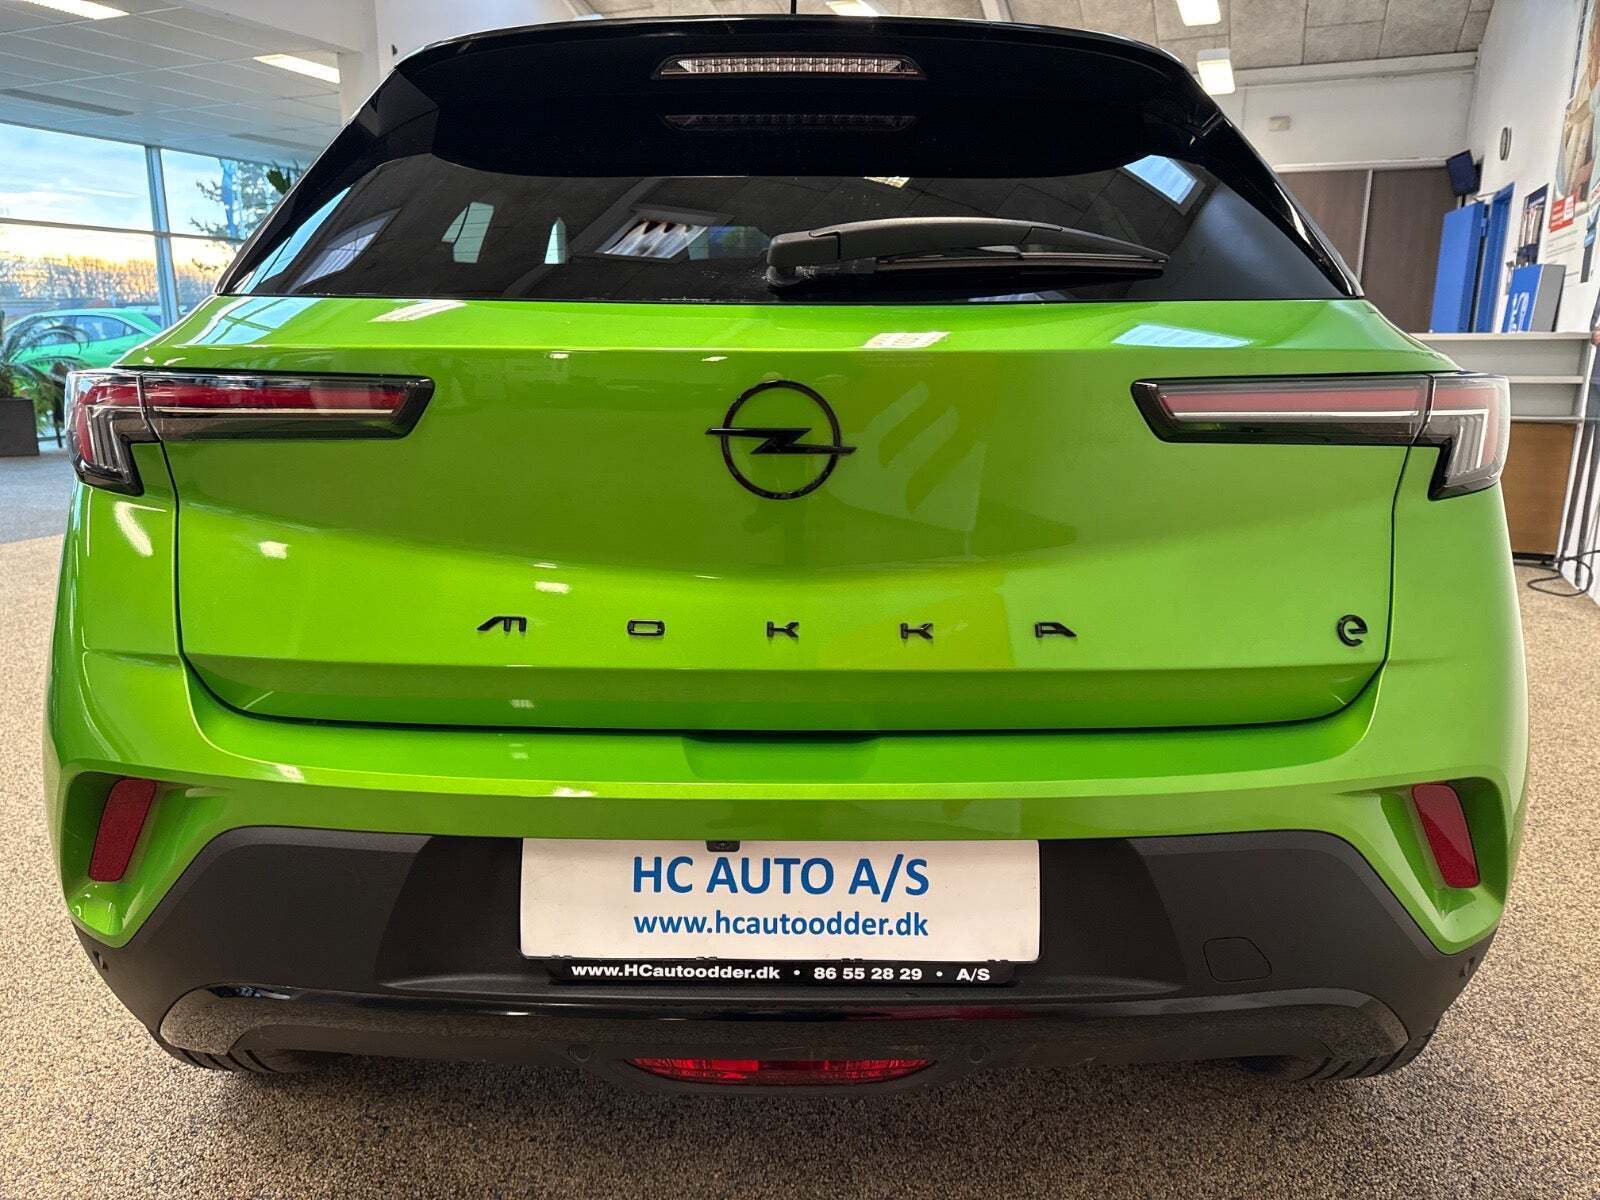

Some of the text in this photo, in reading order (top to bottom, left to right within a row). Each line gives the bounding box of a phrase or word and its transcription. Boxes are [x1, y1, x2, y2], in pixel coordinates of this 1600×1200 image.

[477, 615, 1078, 640] MOKKA
[1336, 613, 1368, 647] e
[633, 854, 930, 903] HC AUTO A/S
[634, 910, 930, 938] www.hcautoodder.dk
[571, 963, 991, 982] www.HCautoodder.dk 86 55 28 29 A/S
